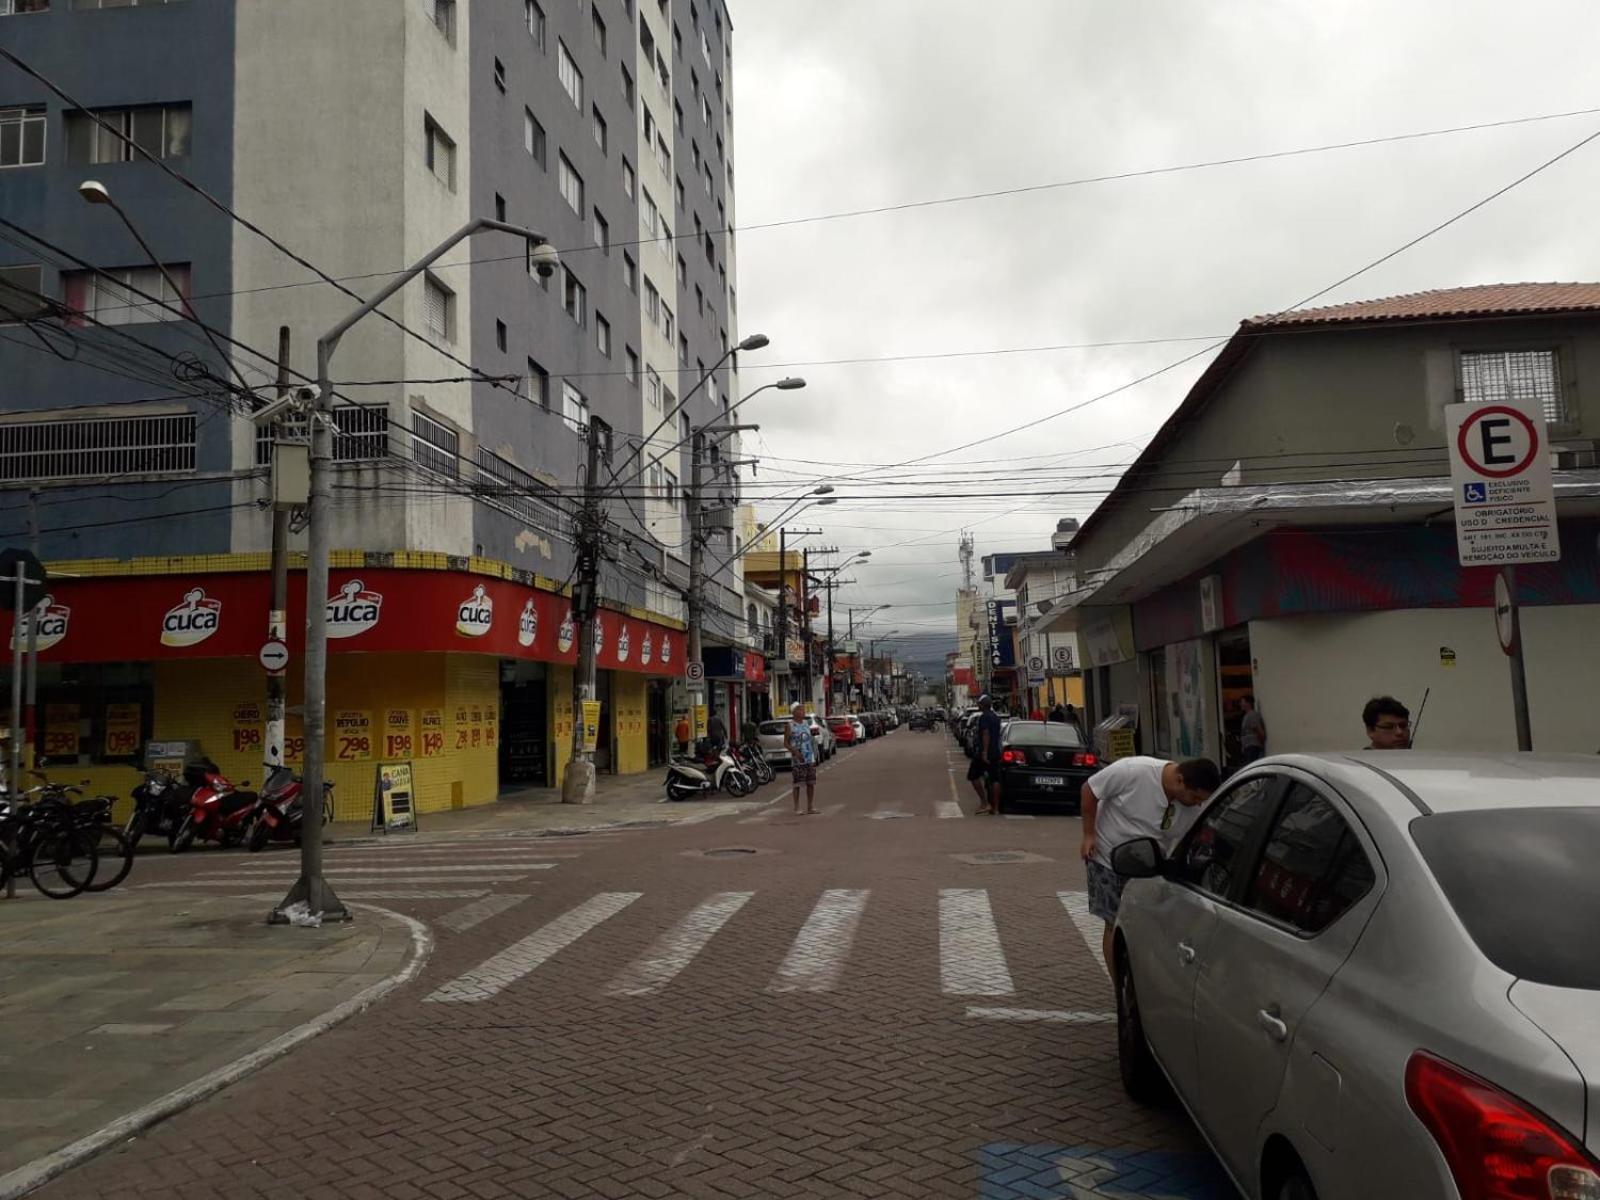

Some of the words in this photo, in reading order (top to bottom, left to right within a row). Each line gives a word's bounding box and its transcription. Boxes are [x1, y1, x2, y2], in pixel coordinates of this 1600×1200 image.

[1480, 418, 1516, 465] E
[1460, 518, 1479, 527] USO
[1495, 514, 1551, 524] CREDENCIAL
[165, 612, 217, 632] cuca
[460, 606, 491, 624] cuca
[987, 601, 1001, 657] DENTISTA
[1032, 659, 1040, 669] E
[1059, 651, 1067, 660] E
[691, 666, 699, 677] E
[339, 736, 369, 759] 2,98
[387, 735, 412, 758] 1,98
[423, 732, 443, 758] 1,48
